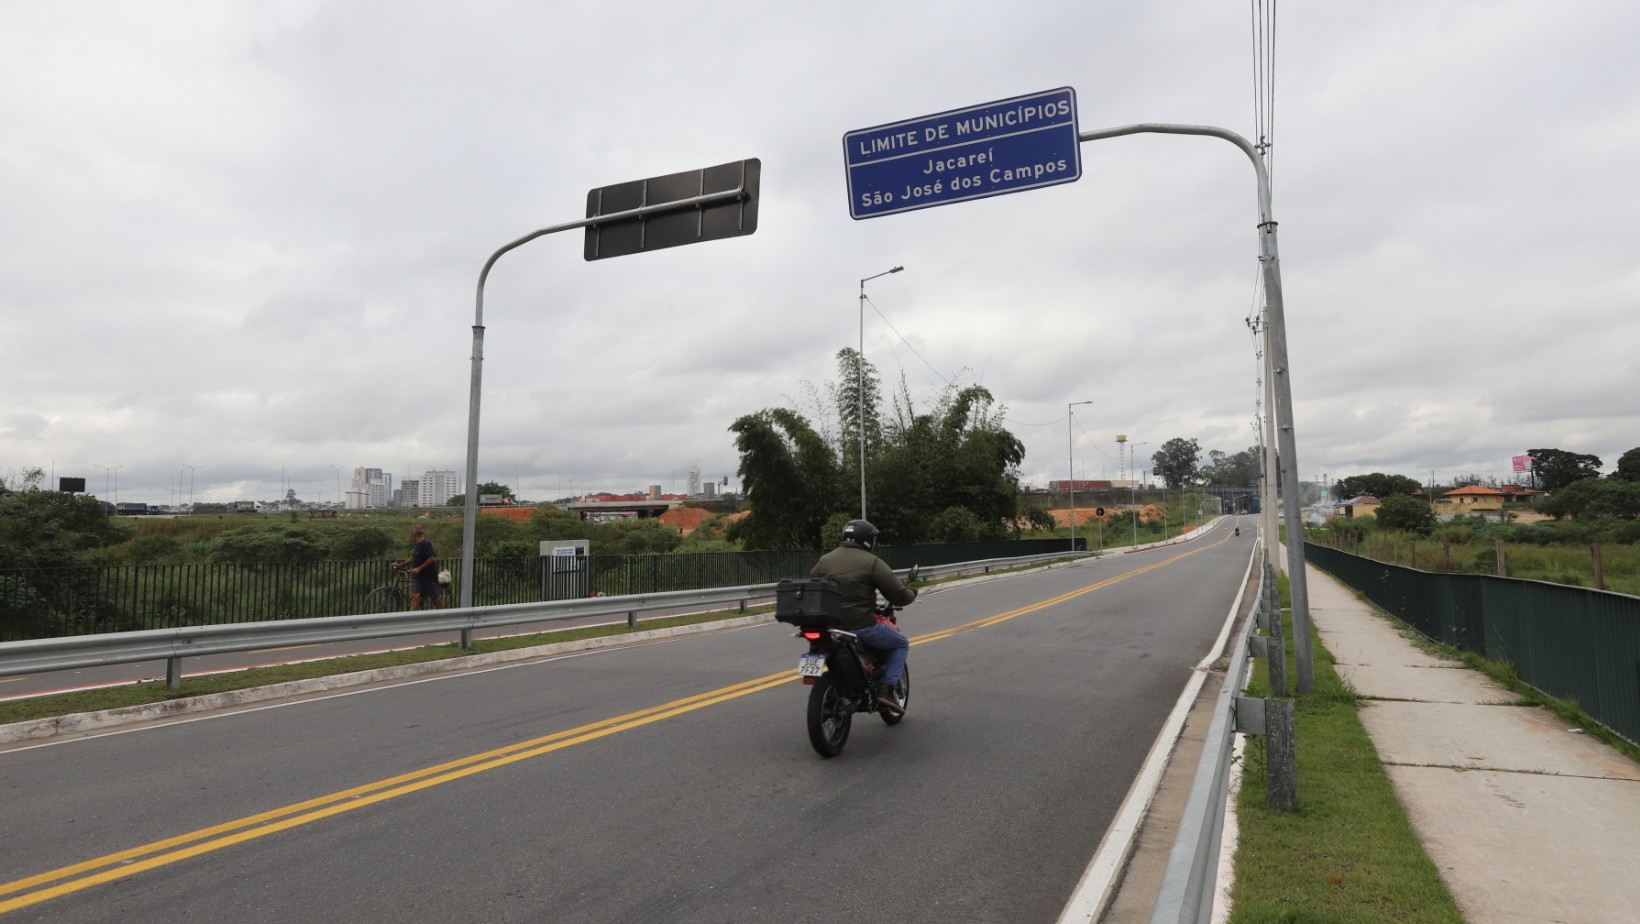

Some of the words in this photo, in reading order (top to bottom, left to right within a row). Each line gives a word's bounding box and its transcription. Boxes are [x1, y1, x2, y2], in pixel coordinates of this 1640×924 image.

[860, 131, 918, 155] LIMITE
[925, 125, 949, 143] DE
[956, 100, 1070, 136] MUNICÍPIOS
[923, 148, 994, 174] Jacareí
[862, 191, 893, 207] São
[901, 181, 942, 200] José
[951, 175, 982, 191] dos
[989, 159, 1067, 184] Campos
[800, 666, 820, 674] 7F27
